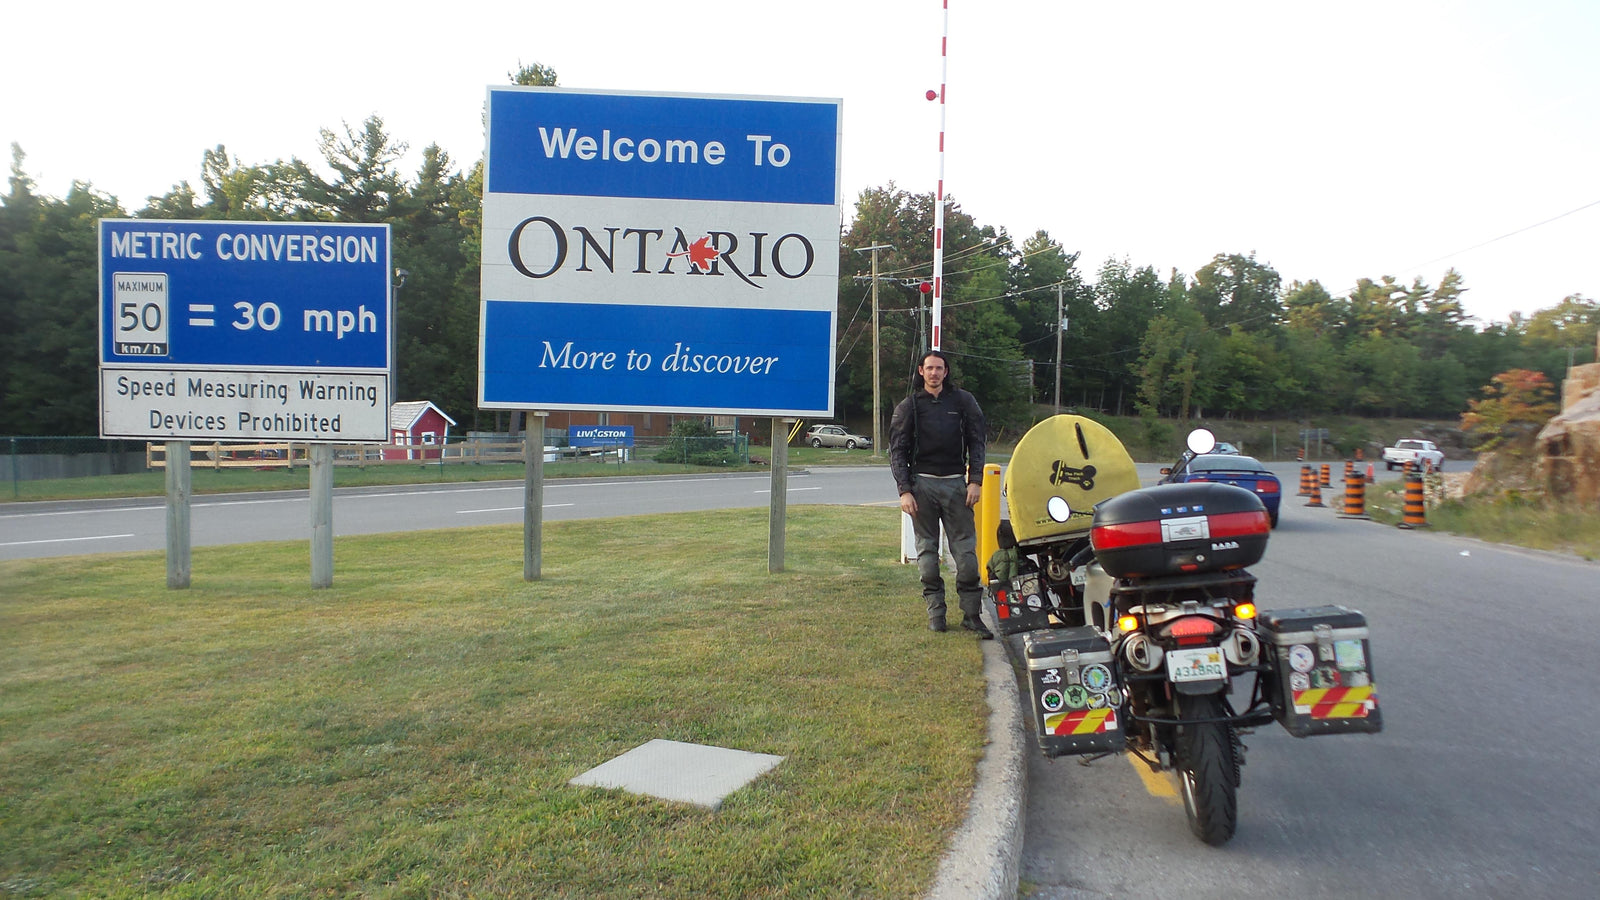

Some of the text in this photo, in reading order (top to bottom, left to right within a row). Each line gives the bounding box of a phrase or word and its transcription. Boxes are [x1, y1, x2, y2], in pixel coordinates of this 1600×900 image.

[538, 127, 791, 168] Welcome To
[111, 231, 377, 263] METRIC CONVERSION
[508, 216, 815, 289] ONTARIO
[117, 281, 163, 293] MAXIMUM
[120, 302, 162, 332] 50
[232, 301, 280, 331] 30
[304, 304, 377, 340] mph
[121, 343, 161, 354] km/h
[539, 341, 779, 375] More to discover
[117, 376, 377, 406] Speed Measuring Warning
[150, 410, 341, 432] Devices Prohibited
[576, 429, 626, 438] LIVINGSTON
